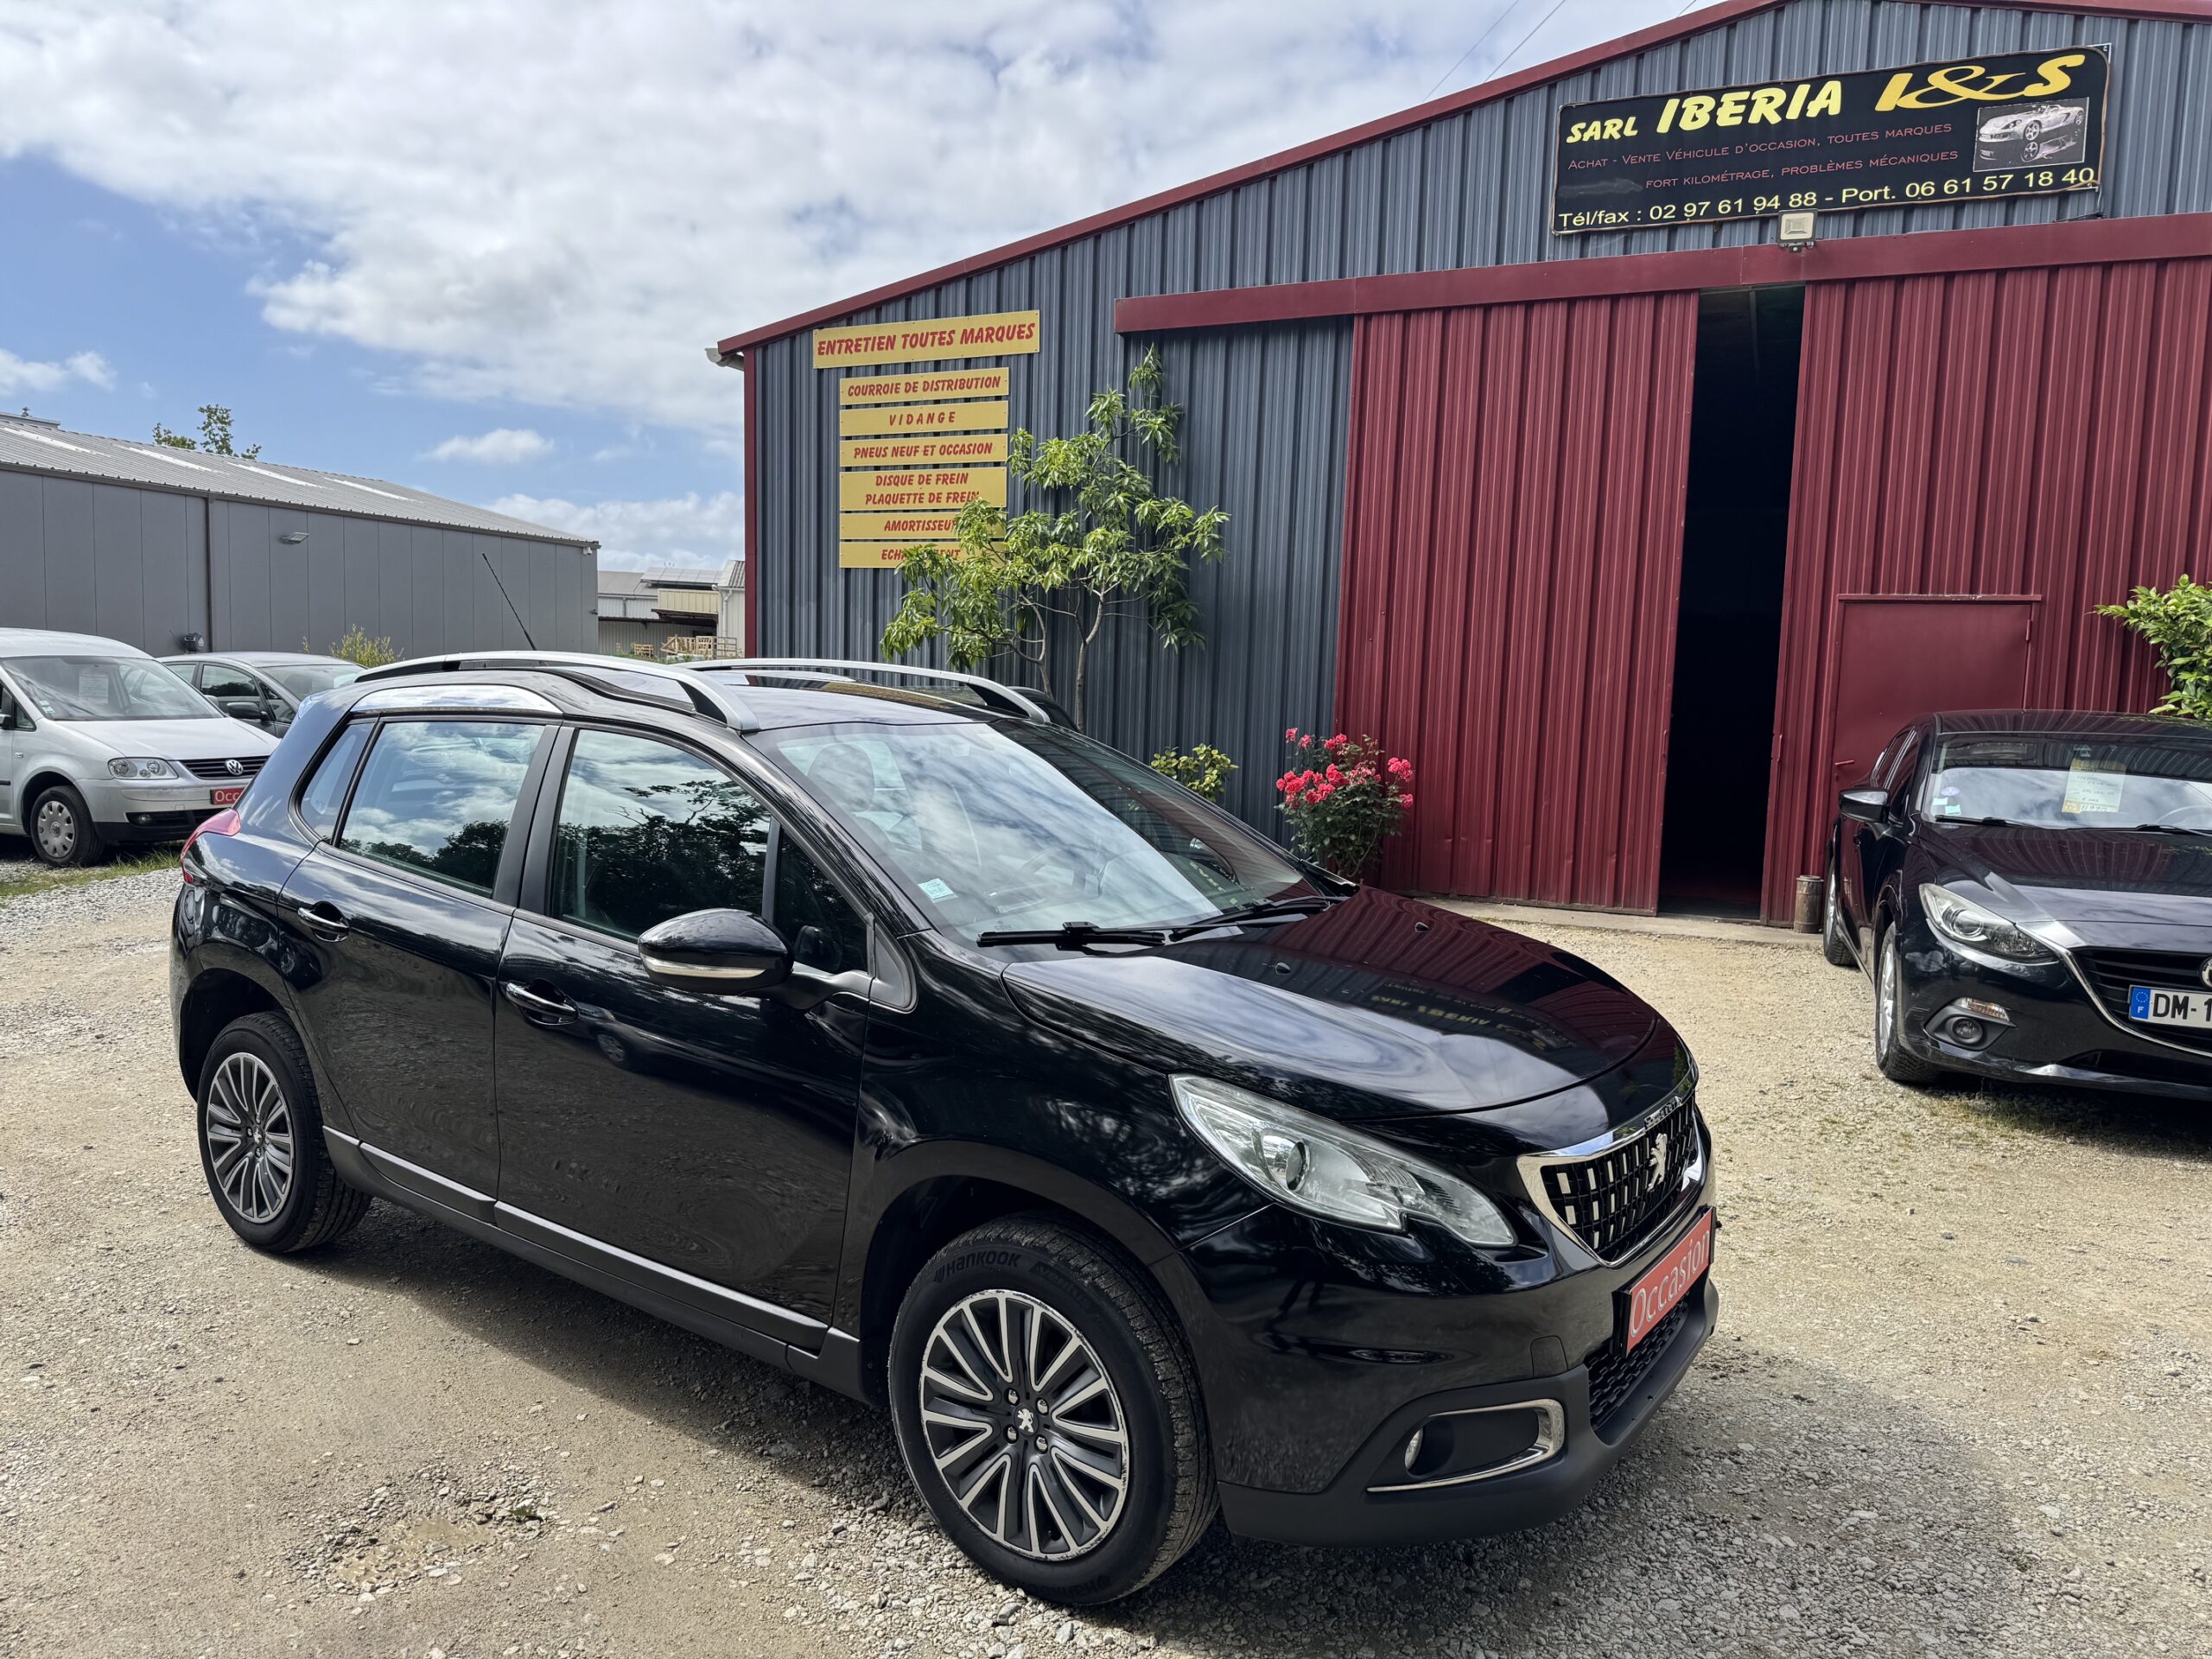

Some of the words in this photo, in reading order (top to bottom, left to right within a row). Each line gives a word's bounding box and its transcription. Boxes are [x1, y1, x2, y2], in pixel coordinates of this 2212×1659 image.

[1566, 116, 1637, 143] SARL
[1656, 80, 1841, 133] IBERIA
[1567, 158, 1608, 169] ACHAT
[1622, 153, 1661, 164] VENTE
[1666, 146, 1728, 160] VÉHICULE
[1827, 130, 1878, 143] TOUTES
[1885, 124, 1952, 137] MARQUES
[1645, 178, 1677, 188] FORT
[1781, 159, 1863, 176] PROBLÈMES
[1869, 150, 1958, 167] MÉCANIQUES
[1559, 209, 1629, 227] Tél/fax
[1649, 204, 1675, 219] 02
[1683, 201, 1711, 217] 97
[1717, 198, 1742, 213] 61
[1752, 194, 1780, 210] 94
[1789, 191, 1817, 207] 88
[1841, 188, 1896, 203] Port.
[1905, 181, 1935, 197] 06
[1943, 178, 1970, 194] 61
[1982, 175, 2013, 190] 57
[2025, 171, 2053, 187] 18
[2062, 168, 2094, 184] 40
[817, 334, 896, 355] ENTRETIEN
[901, 328, 955, 349] TOUTES
[959, 322, 1035, 345] MARQUES
[848, 382, 900, 397] COURROIE
[904, 381, 918, 393] DE
[922, 375, 1001, 391] DISTRIBUTION
[854, 446, 887, 458] PNEUS
[891, 445, 919, 457] NEUF
[923, 444, 936, 455] ET
[939, 442, 992, 454] OCCASION
[875, 474, 913, 486] DISQUE
[918, 474, 931, 485] DE
[935, 472, 968, 484] FREIN
[865, 493, 924, 505] PLAQUETTE
[928, 492, 942, 503] DE
[1630, 1230, 1711, 1338] Occasion
